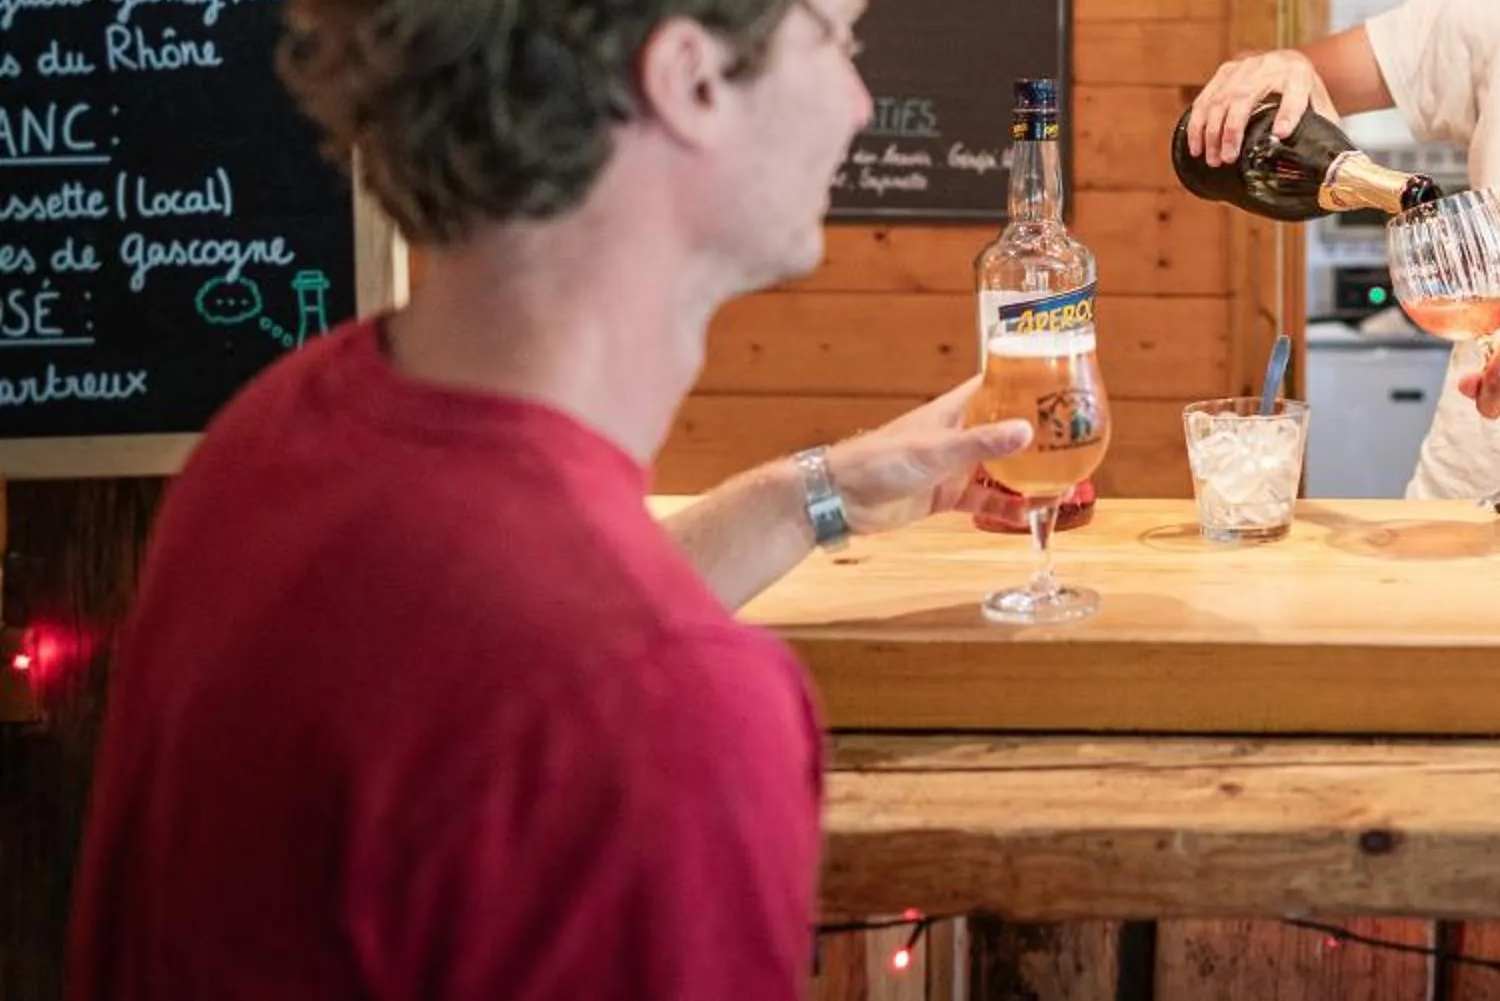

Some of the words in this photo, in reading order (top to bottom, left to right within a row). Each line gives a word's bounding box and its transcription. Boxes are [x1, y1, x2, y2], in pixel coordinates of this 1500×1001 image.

[37, 39, 96, 76] du
[106, 23, 224, 72] Rhône
[0, 181, 109, 222] ssette
[51, 236, 102, 272] de
[0, 277, 94, 337] SÉ:
